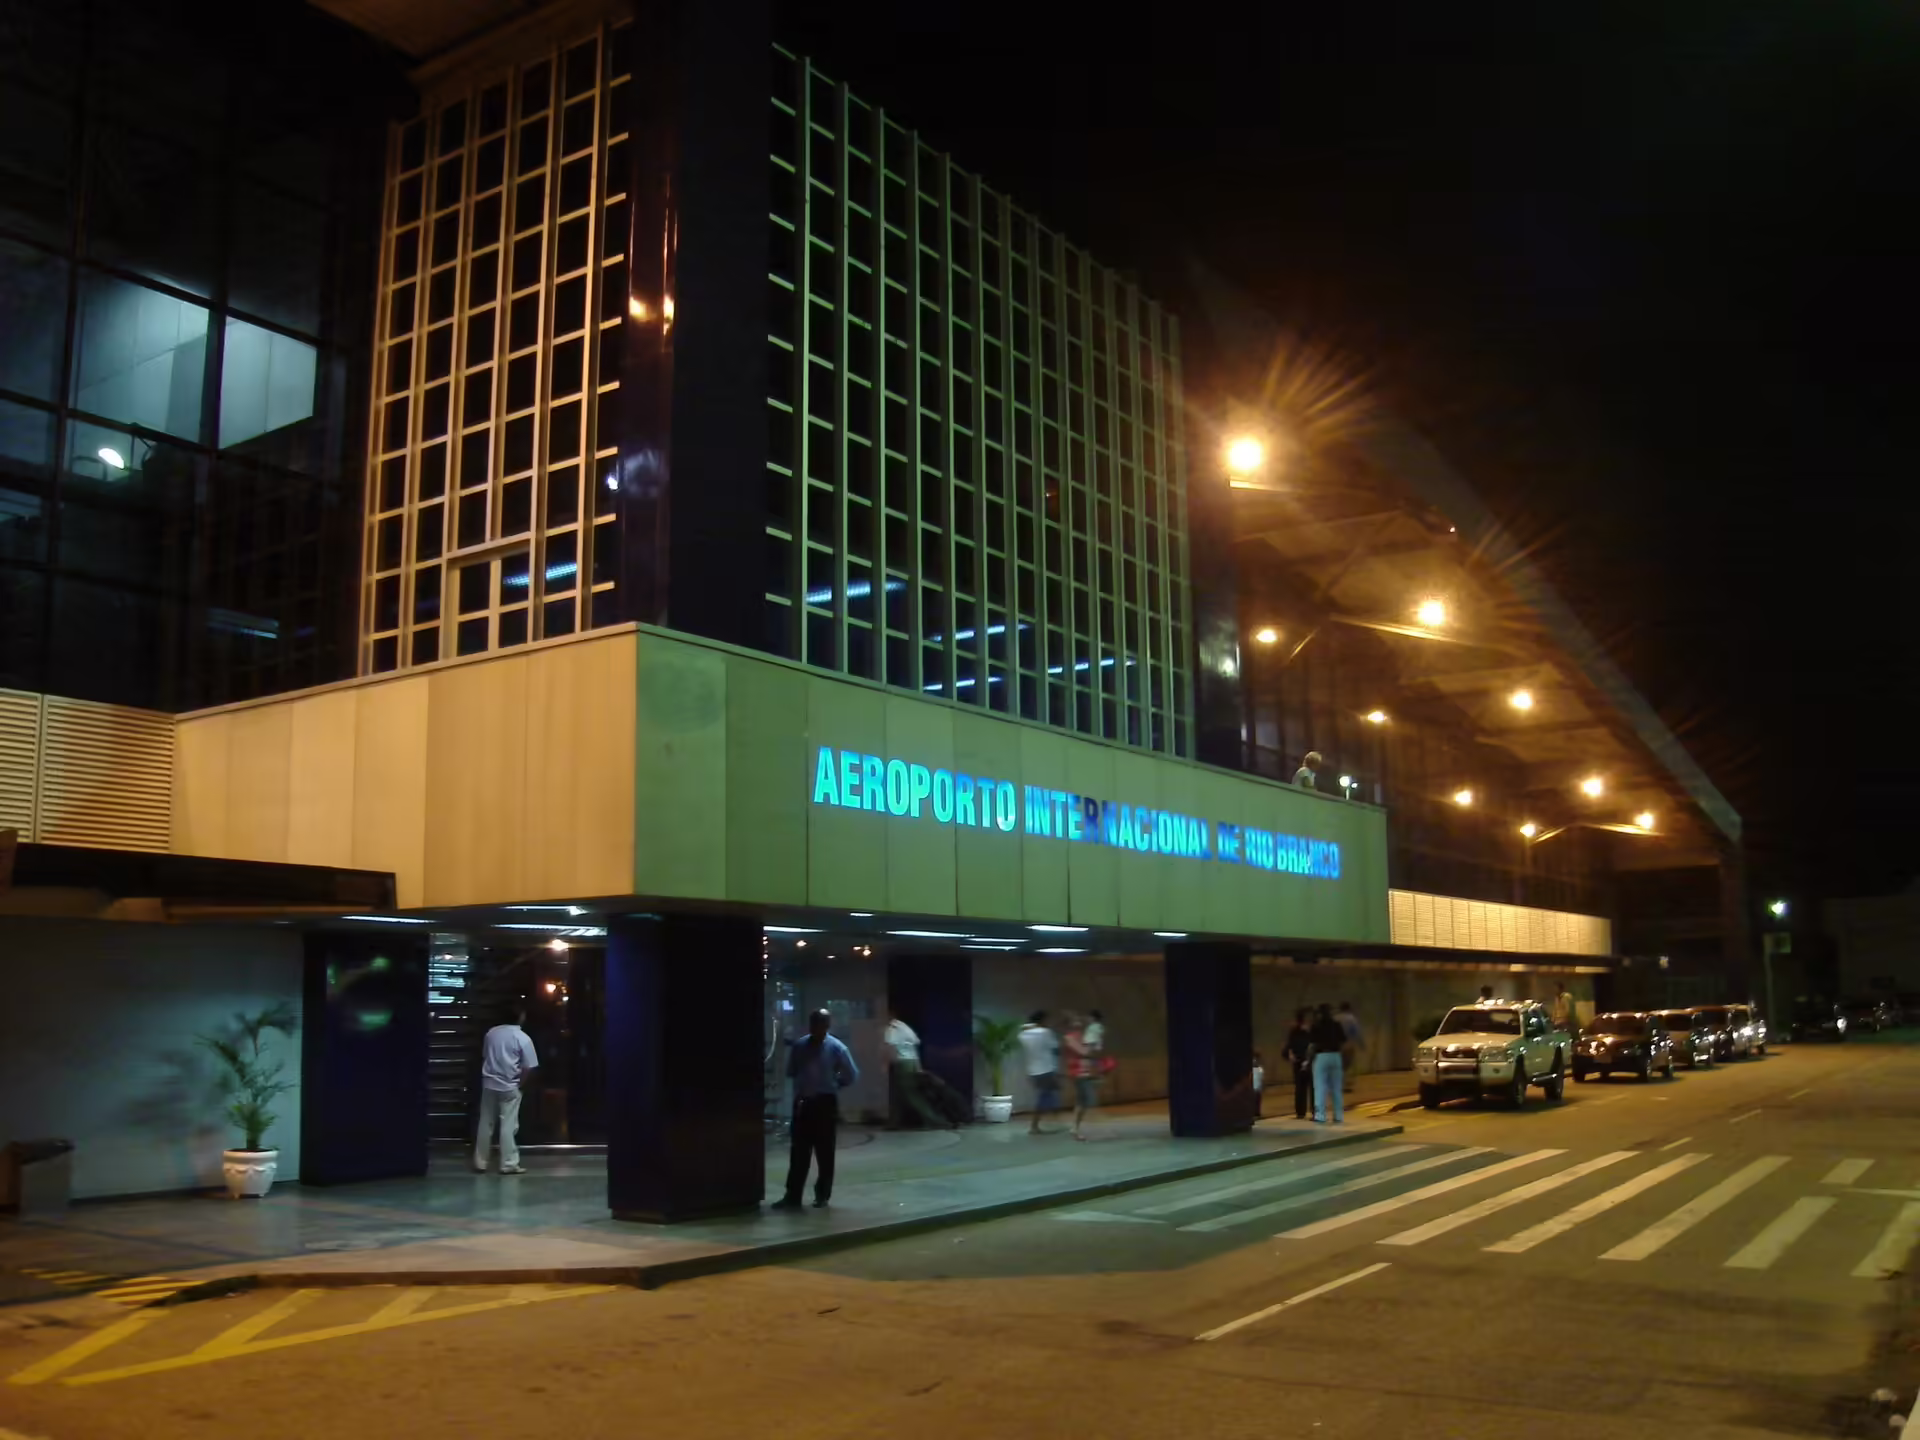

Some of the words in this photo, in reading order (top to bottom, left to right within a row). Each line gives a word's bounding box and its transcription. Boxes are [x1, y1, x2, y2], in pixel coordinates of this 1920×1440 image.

[813, 745, 1016, 832] AEROPORTO
[1024, 785, 1211, 859] INTERNACIONAL
[1217, 822, 1241, 862] DE
[1244, 827, 1274, 870] RIO
[1275, 834, 1341, 879] BRANCO
